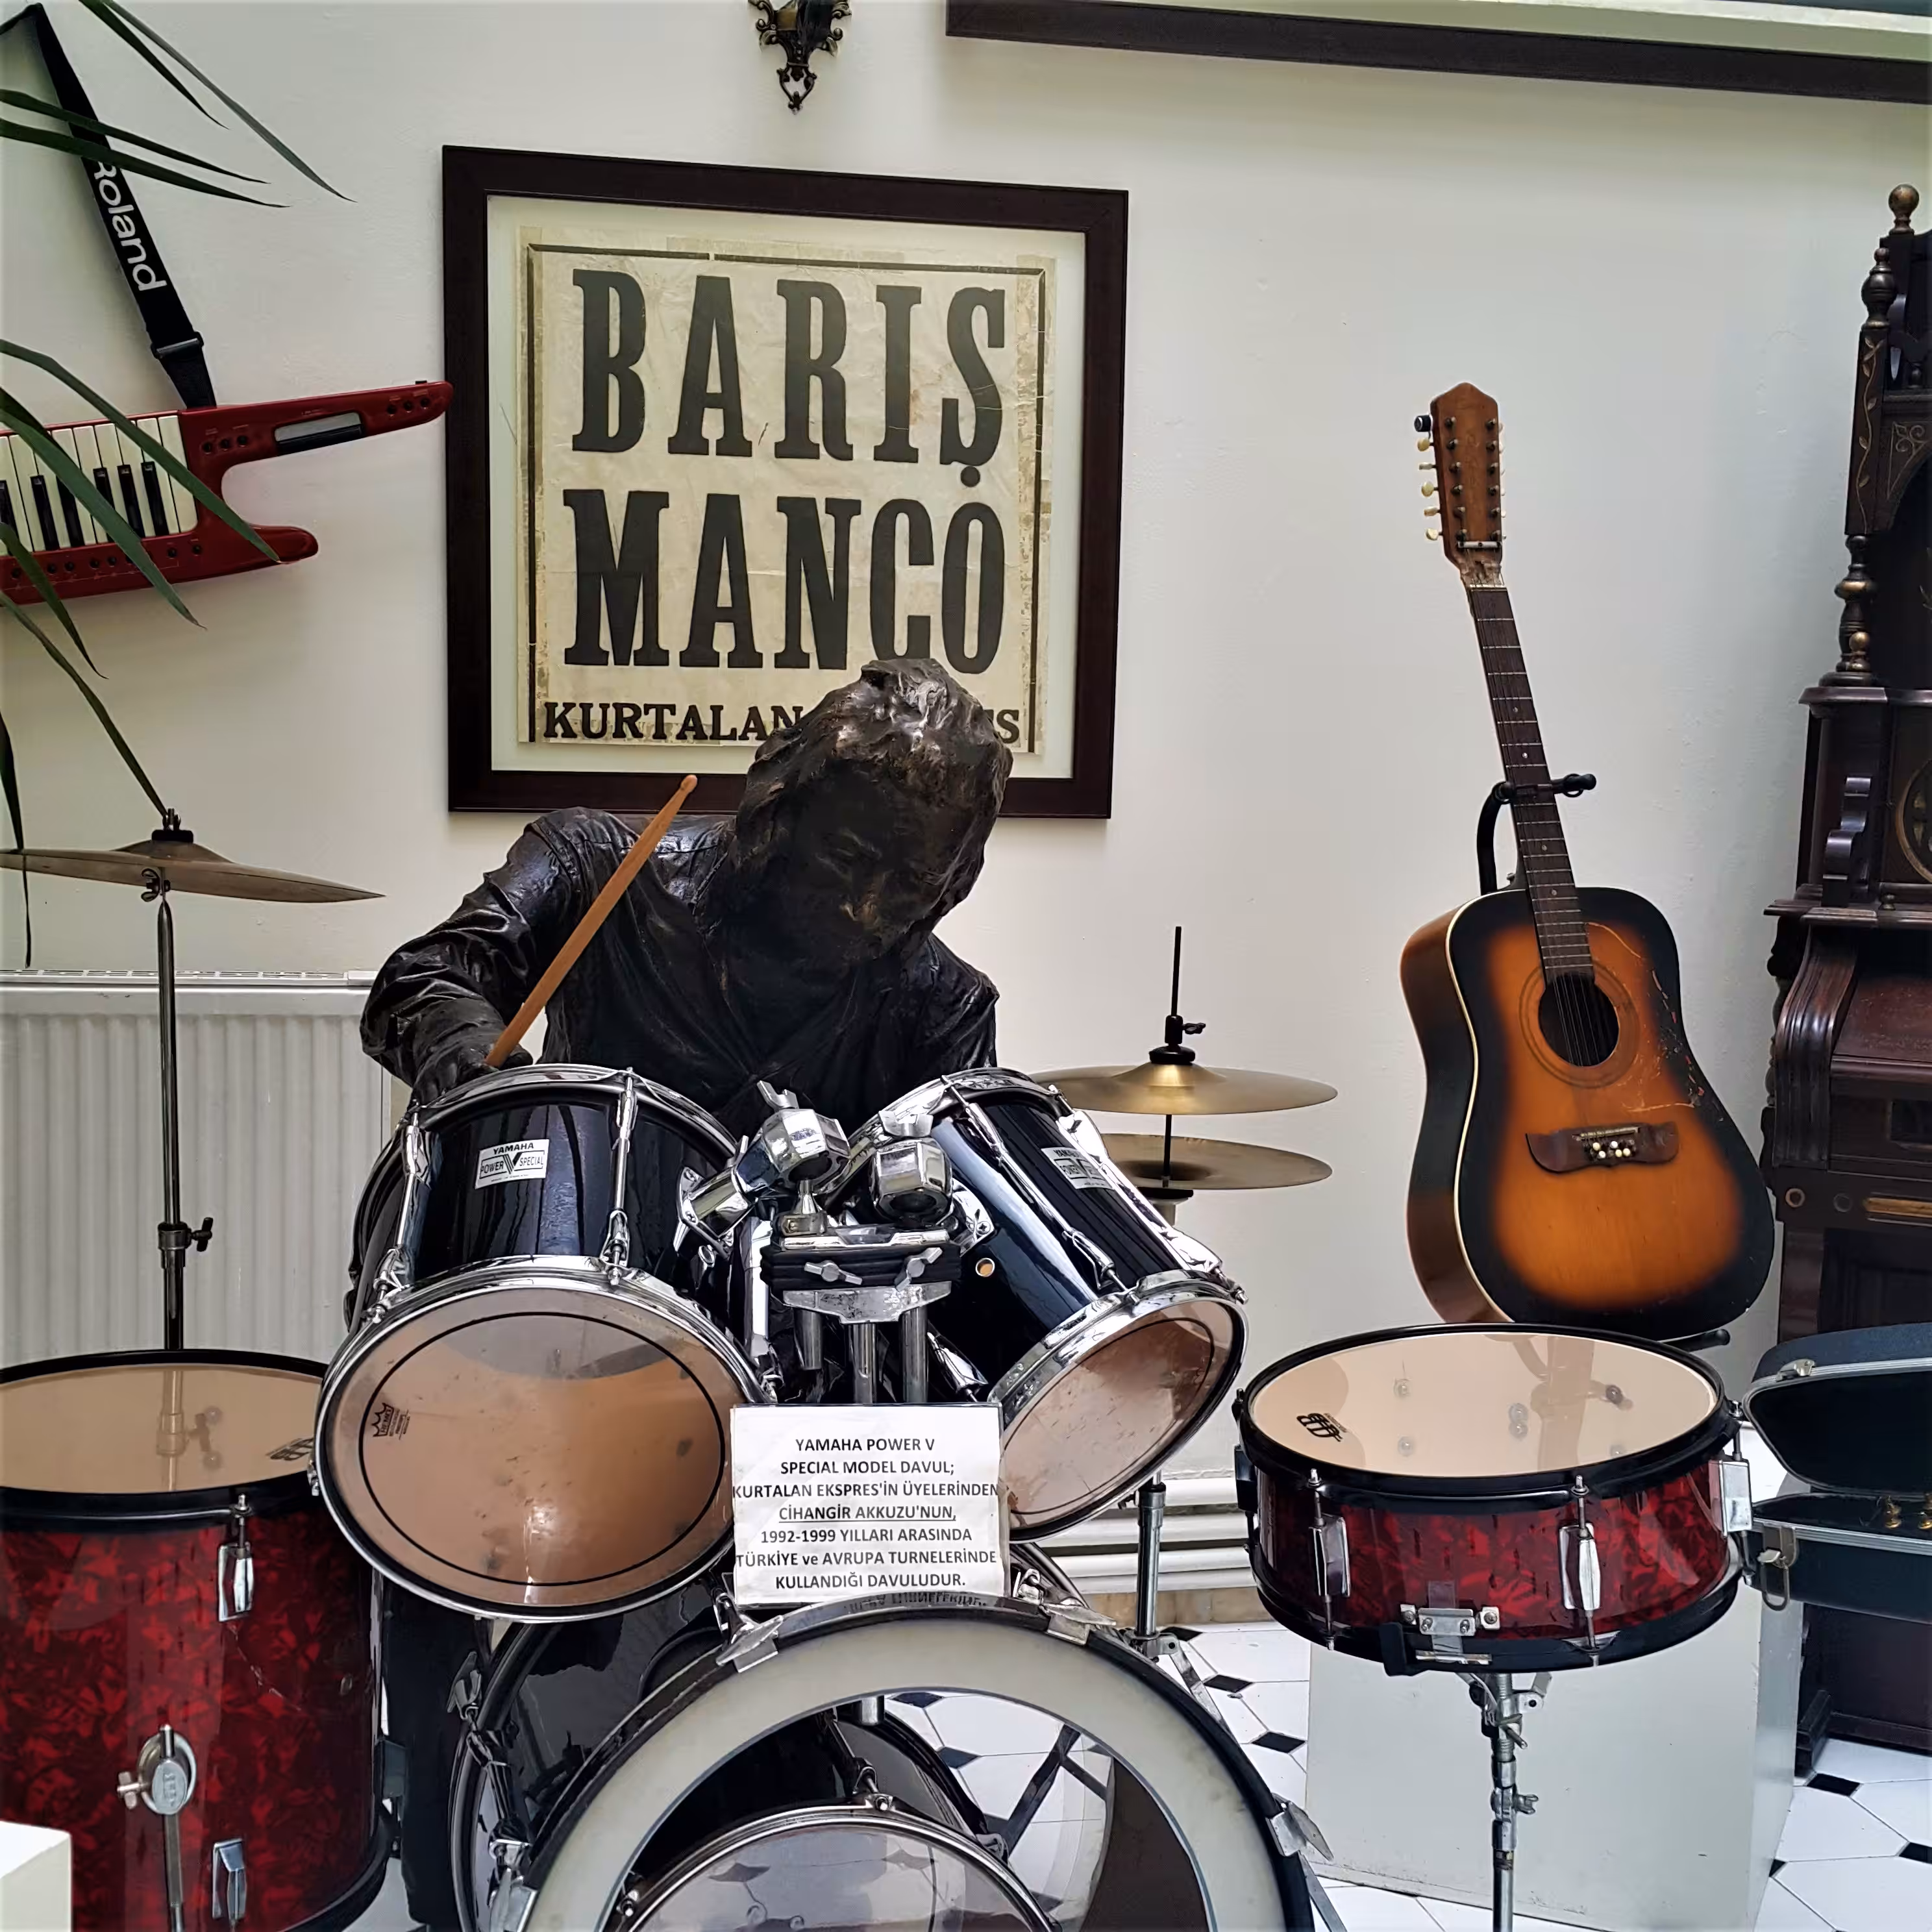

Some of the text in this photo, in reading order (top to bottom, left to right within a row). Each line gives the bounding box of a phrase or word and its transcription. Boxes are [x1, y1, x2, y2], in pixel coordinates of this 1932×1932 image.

[493, 1143, 534, 1155] YAMAHA
[480, 1161, 504, 1174] POWER
[519, 1155, 544, 1167] SPECIAL
[795, 1438, 935, 1452] YAMAHA POWER V
[780, 1461, 954, 1476] SPECIAL MODEL DAVUL;
[732, 1480, 998, 1498] KURTALAN EKSPRES'İN ÜYELERİNDEN
[779, 1504, 956, 1520] CİHANGİR AKKUZU'NUN,
[762, 1528, 972, 1543] 1992-1999 YILLARI ARASINDA
[736, 1548, 996, 1567] TÜRKİYE ve AVRUPA TURNELERİNDE
[776, 1572, 965, 1589] KULLANDIĞI DAVULUDUR.
